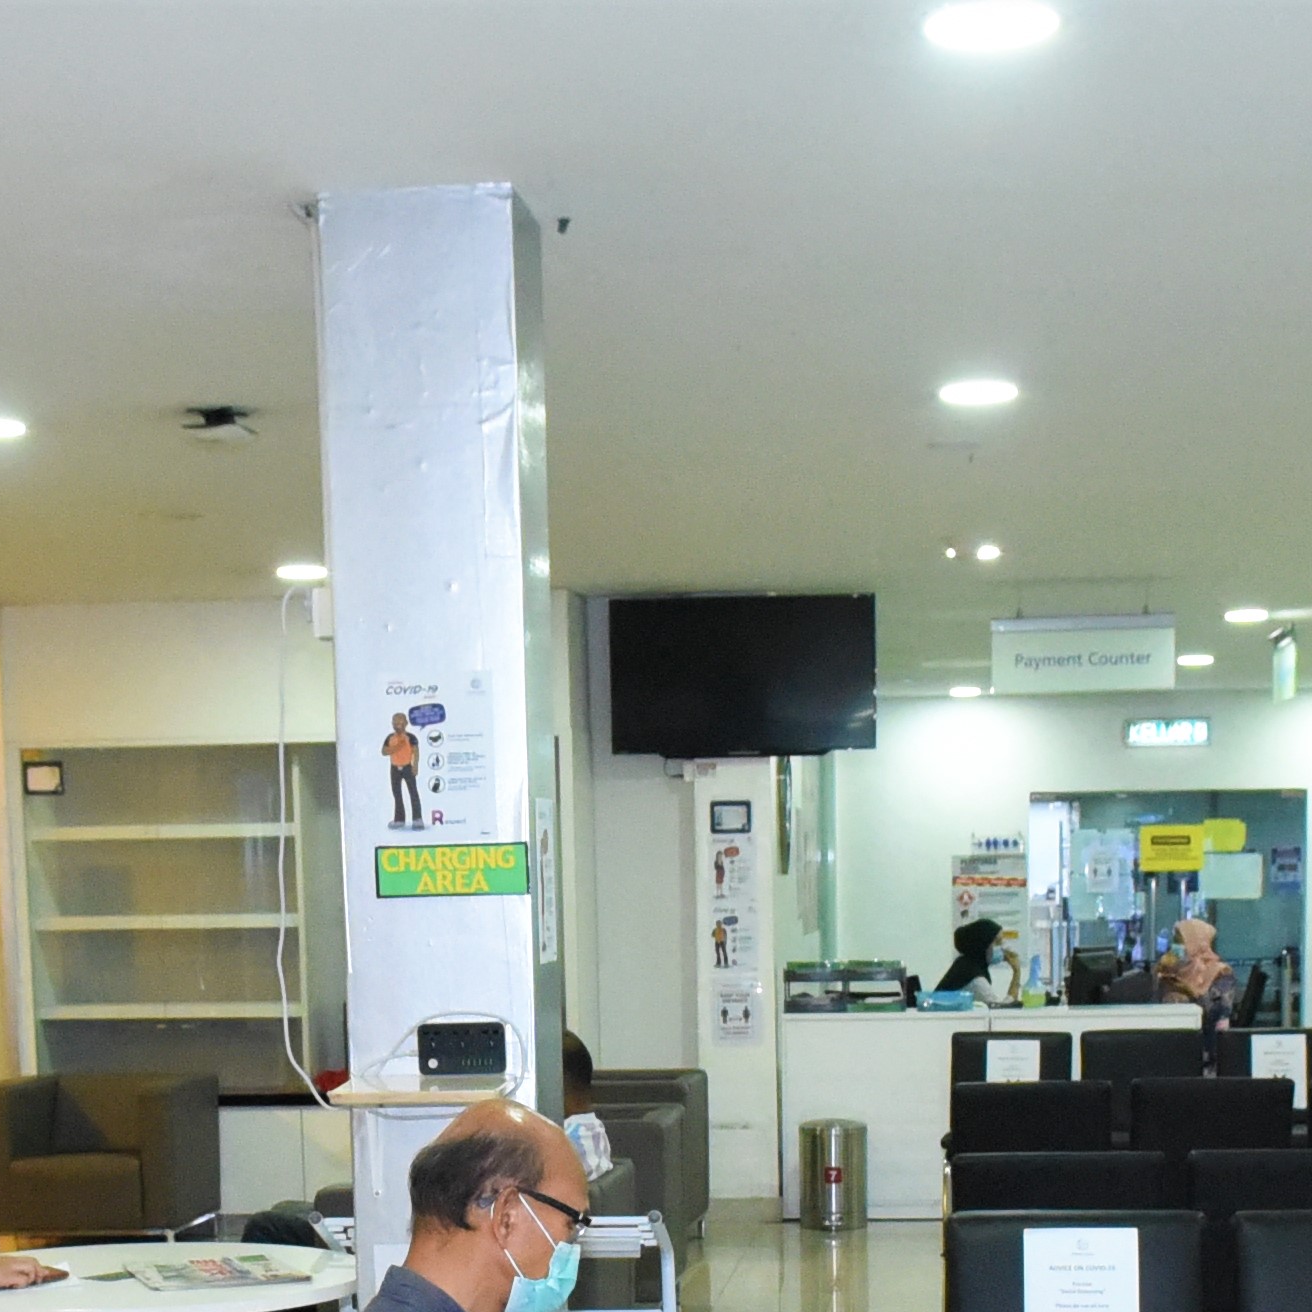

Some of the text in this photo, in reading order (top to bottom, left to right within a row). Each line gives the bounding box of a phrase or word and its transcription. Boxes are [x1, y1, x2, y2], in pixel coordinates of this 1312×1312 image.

[1014, 651, 1152, 671] Payment Counter
[385, 684, 439, 697] COVID-19
[380, 844, 516, 873] CHARGING
[416, 869, 488, 894] AREA
